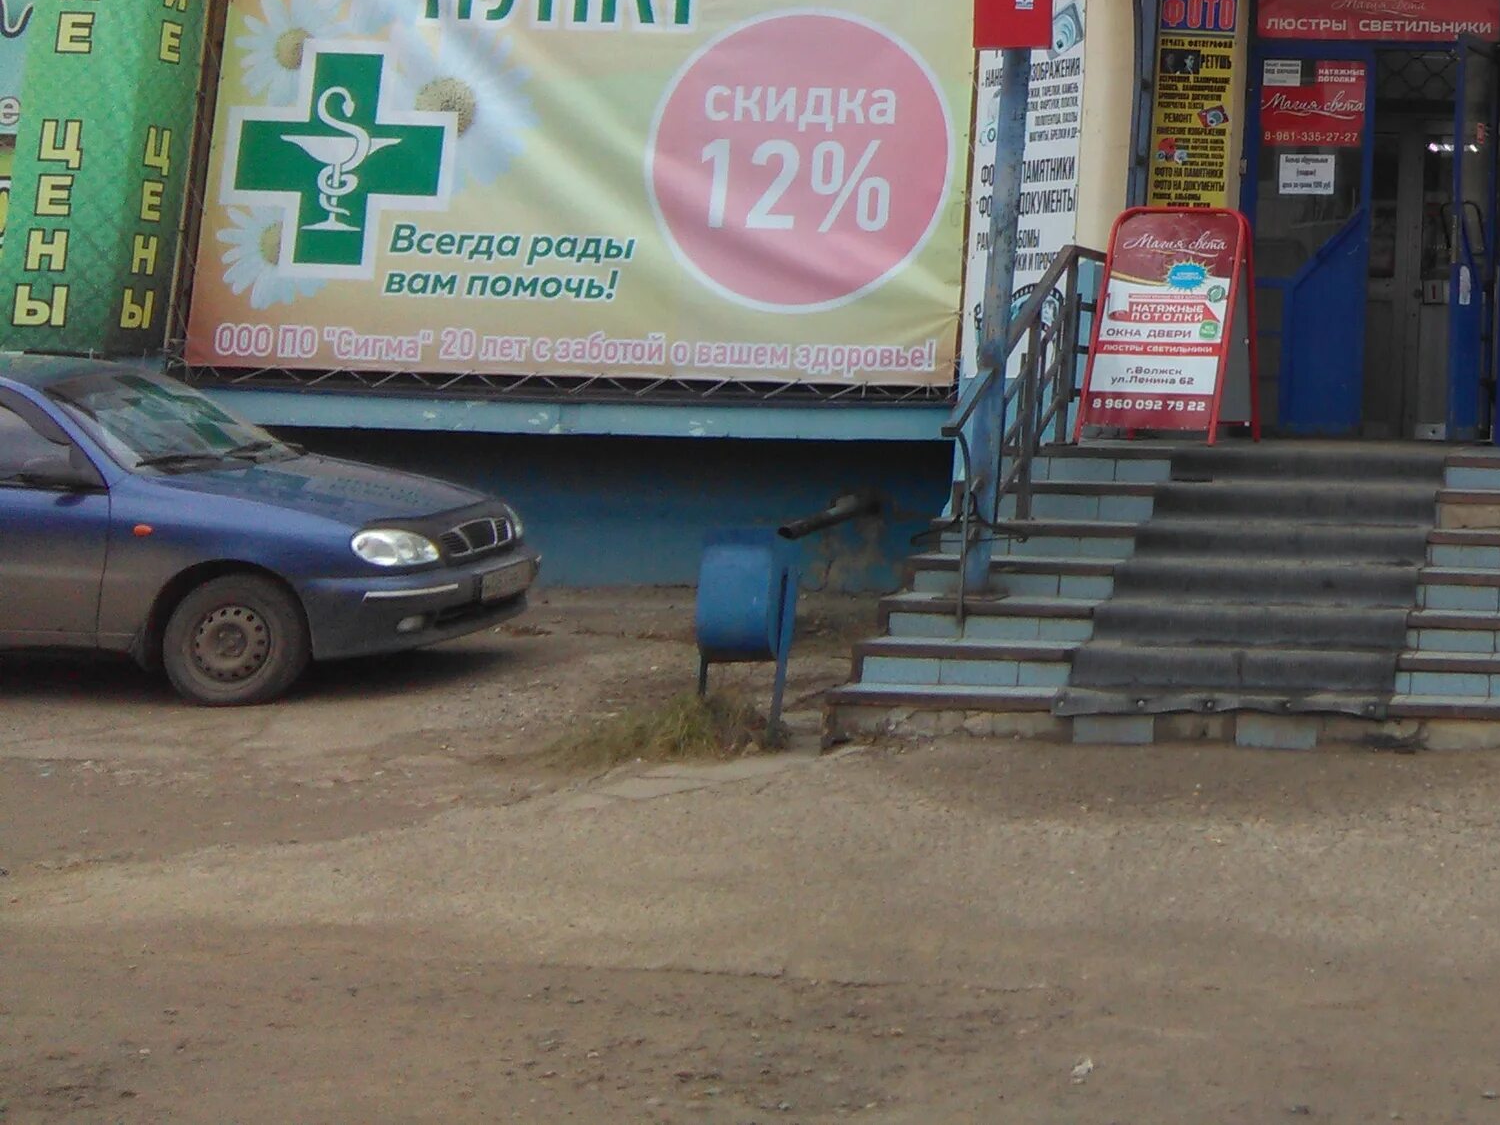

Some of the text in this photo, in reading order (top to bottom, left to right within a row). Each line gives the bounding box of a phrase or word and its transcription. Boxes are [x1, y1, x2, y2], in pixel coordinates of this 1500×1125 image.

[1266, 18, 1492, 35] ЛЮСТРЫ СВЕТИЛЬНИКИ
[1030, 56, 1081, 83] ЗОБРАЖЕНИЯ
[1318, 68, 1365, 76] НАТЯЖНЫЕ
[1262, 90, 1365, 112] Магия света
[1163, 112, 1193, 124] РЕМОНТ
[1154, 166, 1173, 178] ФОТО
[699, 137, 893, 233] 12%
[1153, 179, 1172, 191] ФОТО
[1019, 187, 1076, 217] ДОКУМЕНТЫ
[11, 118, 83, 328] ЦЕНЫ
[119, 124, 172, 331] ЦЕНЫ
[388, 223, 636, 266] Всегда рады
[1123, 230, 1228, 250] Магия света
[384, 269, 619, 301] вам помочь!
[1130, 312, 1204, 322] ПОТОЛКИ
[1131, 304, 1205, 314] НАТЯЖНЫЕ
[1106, 328, 1142, 338] ОКНА
[1146, 329, 1192, 339] ДВЕРИ
[215, 324, 272, 356] ООО
[277, 325, 319, 358] ПО
[323, 327, 433, 361] "Сигма"
[440, 328, 478, 360] 20
[480, 335, 531, 362] лет
[554, 331, 665, 365] заботой
[696, 342, 790, 369] вашем
[795, 340, 936, 375] здоровье!
[1103, 344, 1213, 354] ЛЮСТРЫ СВЕТИЛЬНИКИ
[1125, 366, 1182, 376] г.Волжск
[1110, 375, 1195, 386] ул.Ленина 62
[1092, 397, 1102, 409] 8
[1104, 398, 1132, 410] 960
[1135, 399, 1163, 411] 092
[1186, 400, 1206, 412] 22
